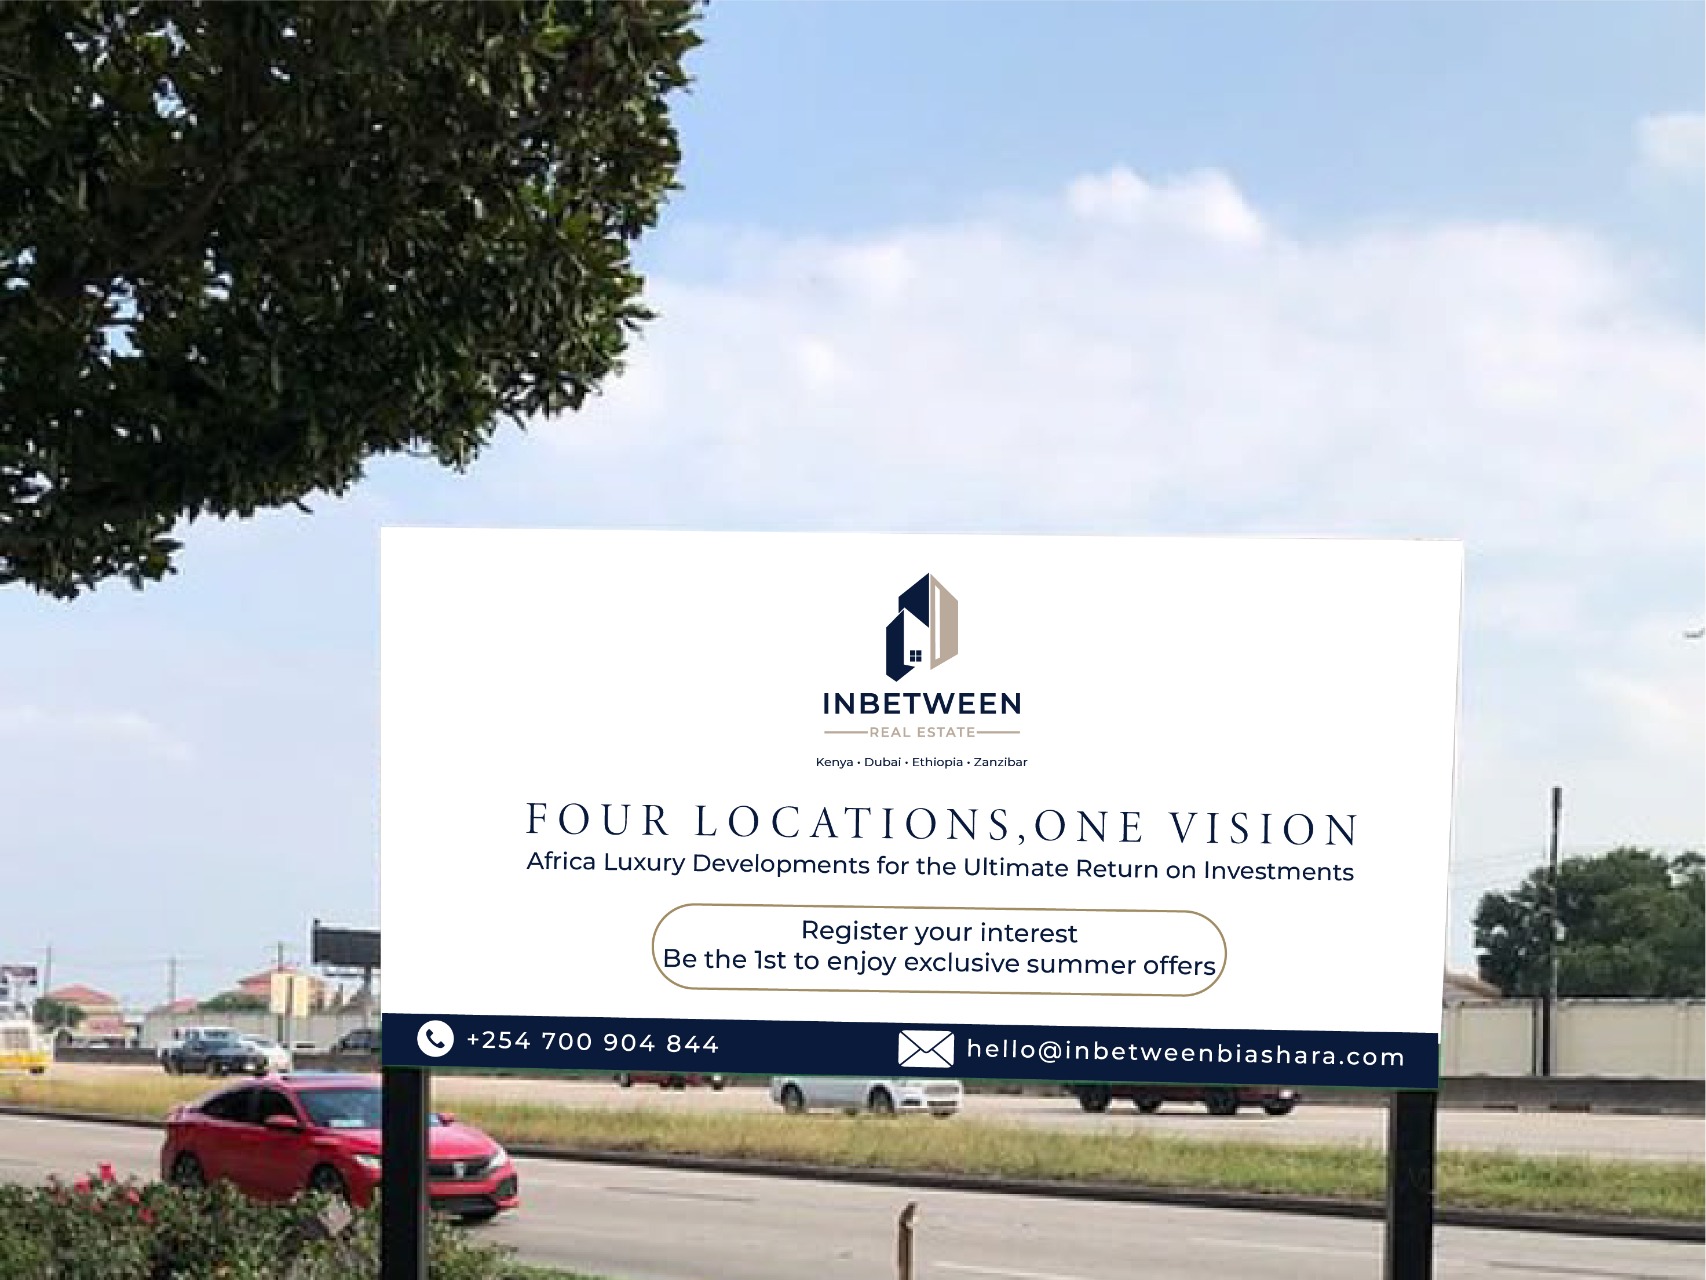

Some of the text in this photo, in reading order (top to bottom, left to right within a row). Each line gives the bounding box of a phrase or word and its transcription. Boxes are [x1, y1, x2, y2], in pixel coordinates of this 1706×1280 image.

[824, 693, 1020, 714] INBETWEEN
[870, 727, 975, 737] REAL ESTATE
[817, 757, 1028, 769] Kenya Dubai Ethiopia Zanzibar
[526, 803, 669, 835] FOUR
[1168, 812, 1357, 845] VISION
[526, 851, 1354, 881] Africa Luxury Developments for the Ultimate Return on Investments
[803, 920, 1078, 945] Register your interest
[664, 949, 1216, 976] Be the 1st to enjoy exclusive summer offers
[468, 1031, 718, 1053] +254 700 904 844
[968, 1039, 1403, 1065] hello@inbetweenbiashara.com
